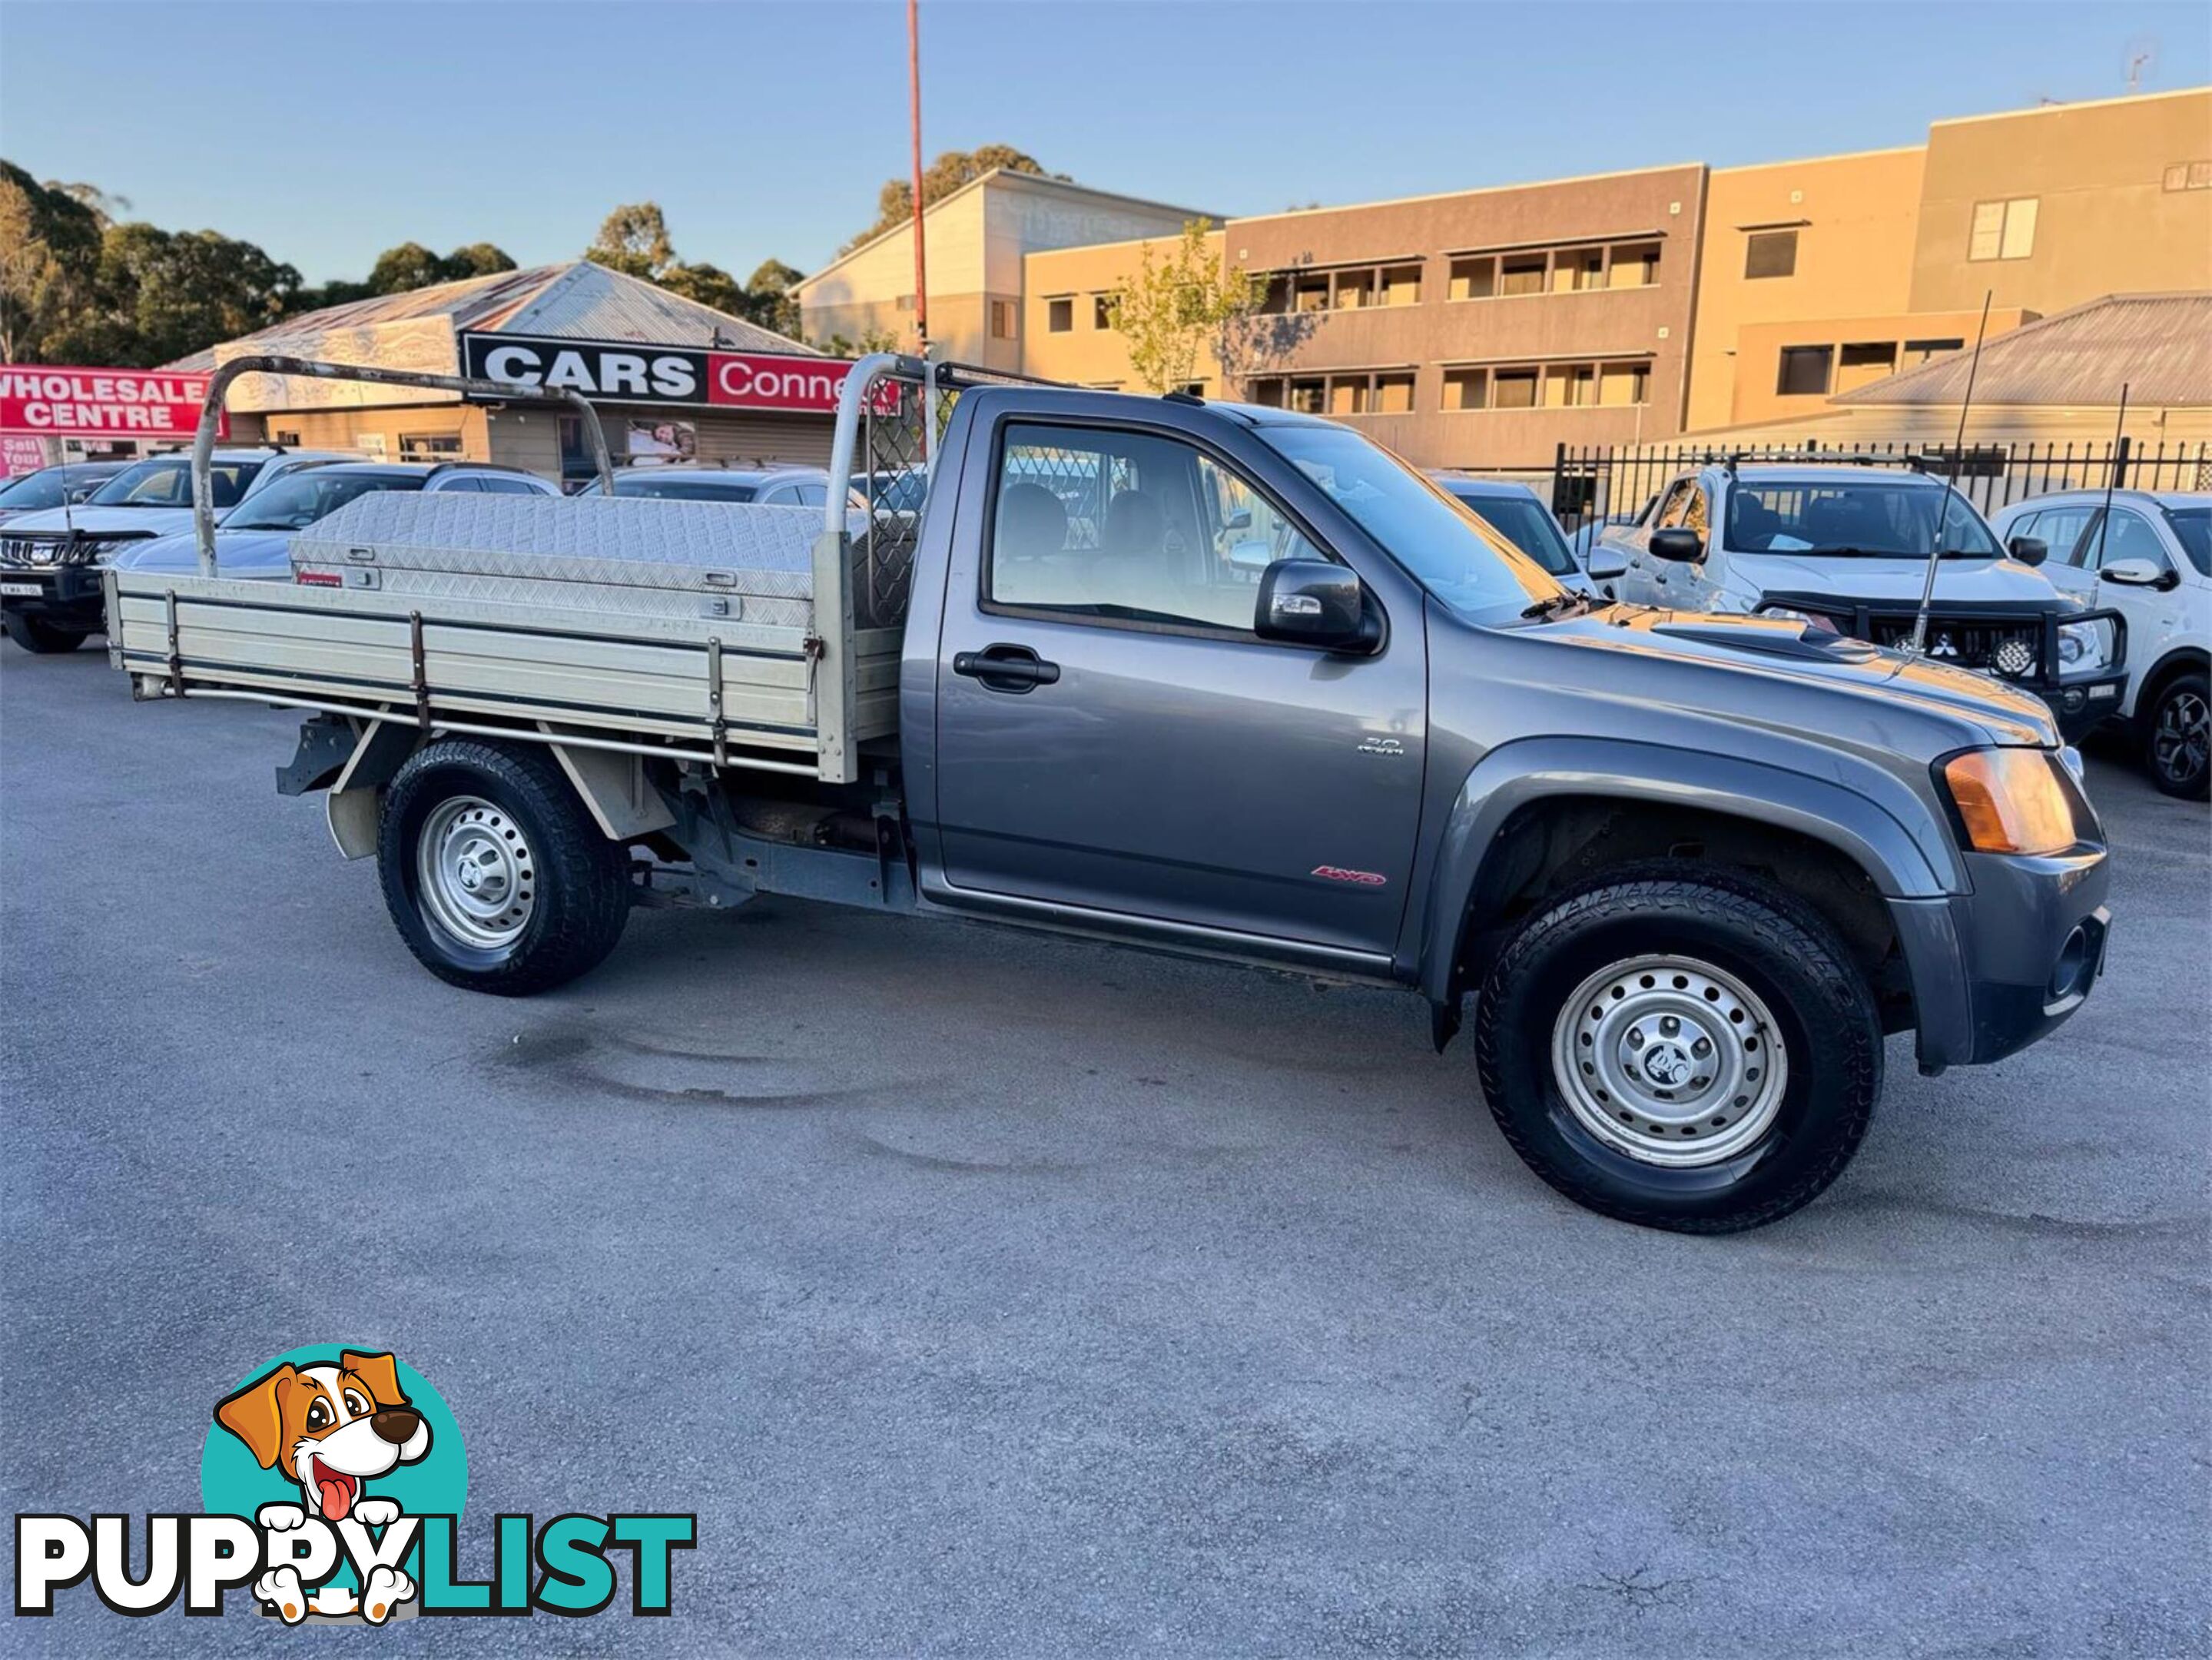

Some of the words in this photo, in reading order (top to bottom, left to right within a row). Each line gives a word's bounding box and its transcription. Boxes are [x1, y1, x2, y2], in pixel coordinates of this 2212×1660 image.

[485, 347, 696, 397] CARS
[24, 401, 174, 428] CENTRE
[3, 439, 36, 452] Sell
[2, 452, 40, 465] Your
